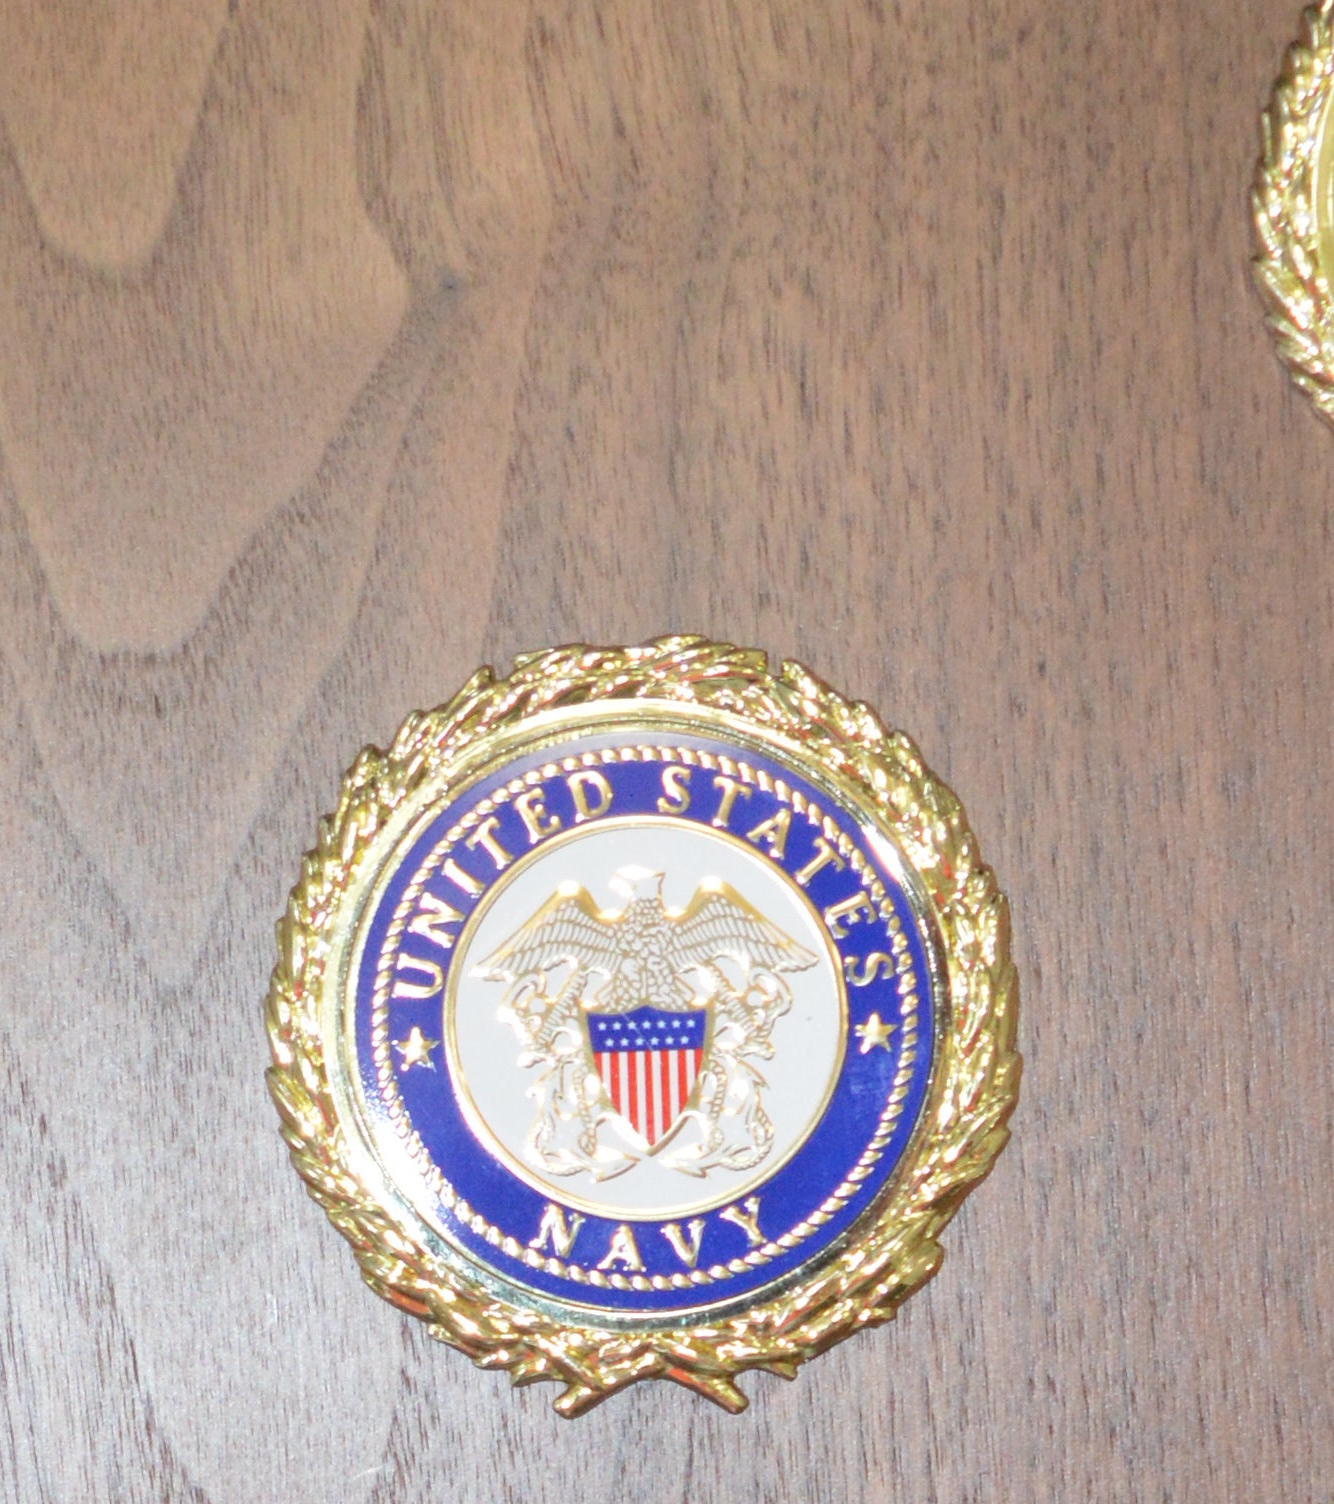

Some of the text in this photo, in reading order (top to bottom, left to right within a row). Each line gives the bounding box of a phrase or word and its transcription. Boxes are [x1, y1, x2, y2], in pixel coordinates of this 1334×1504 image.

[391, 764, 896, 1000] UNITED STATES
[530, 1198, 769, 1272] NAVY
